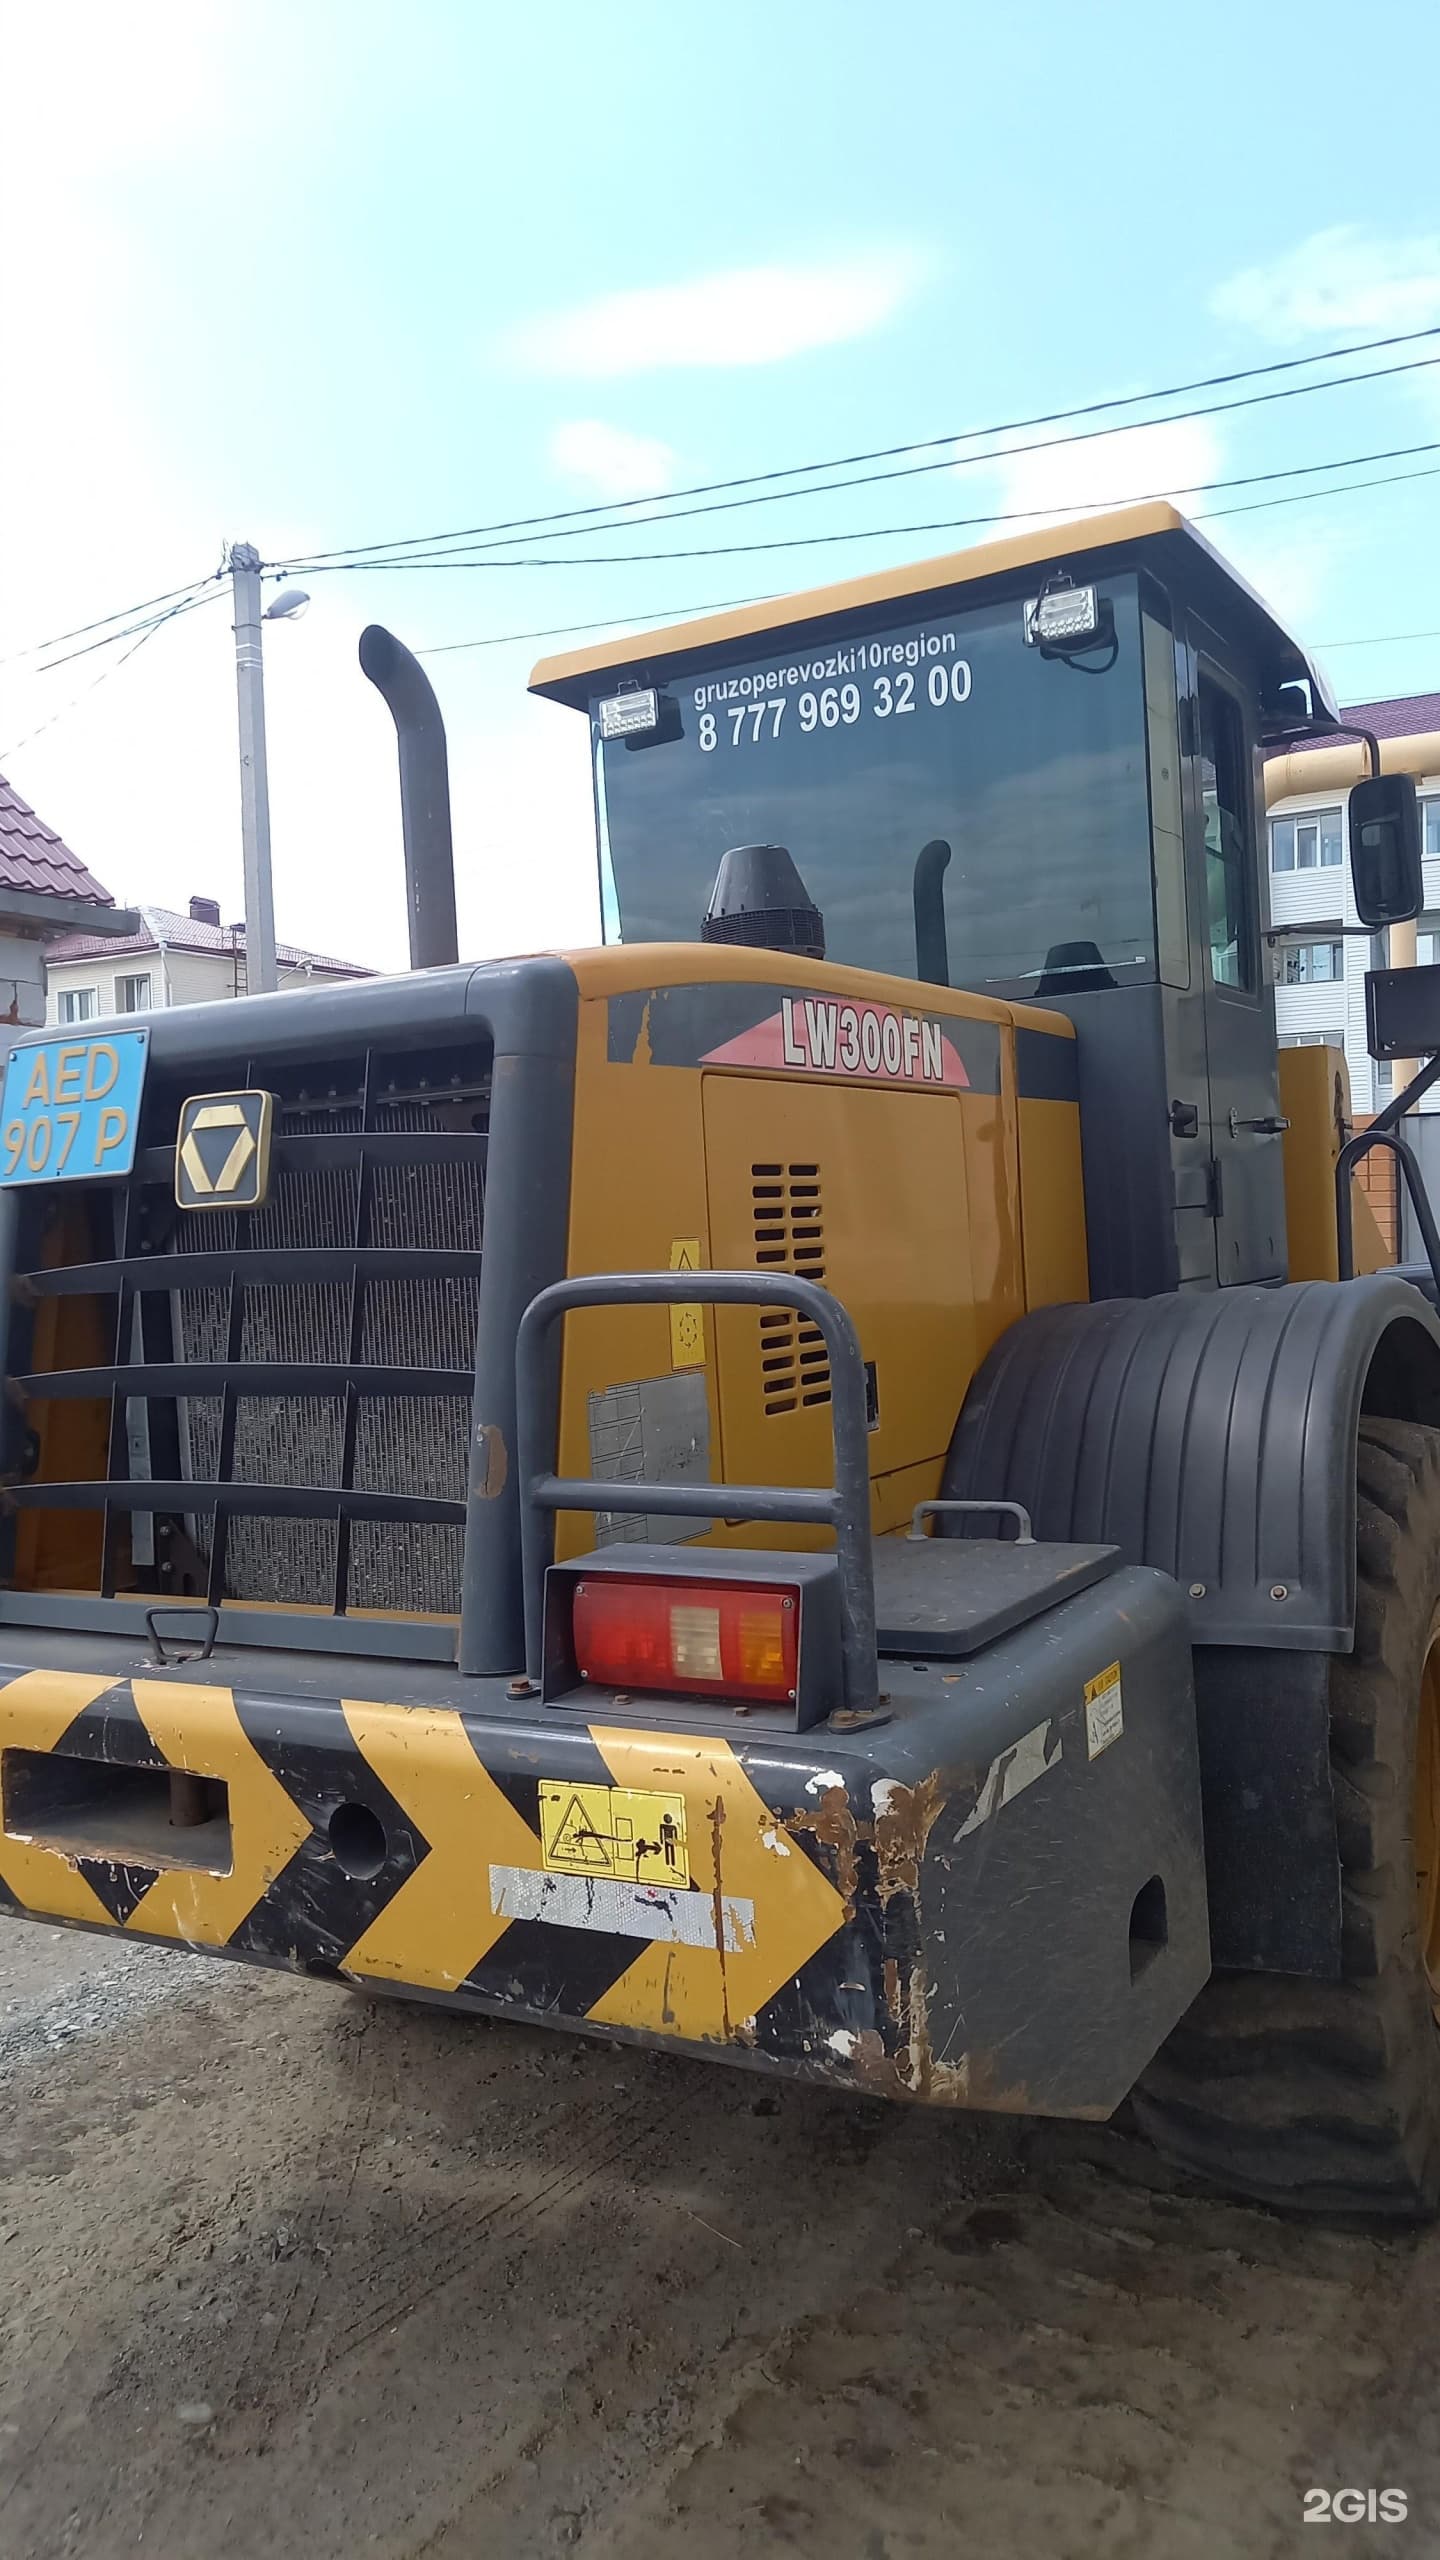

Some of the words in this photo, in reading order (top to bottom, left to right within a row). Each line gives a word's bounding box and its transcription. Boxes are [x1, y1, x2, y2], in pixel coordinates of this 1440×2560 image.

[694, 632, 957, 711] gruzoperevozki10region
[699, 713, 718, 751] 8
[728, 697, 787, 746] 777
[799, 683, 861, 732] 969
[873, 672, 916, 718] 32
[927, 661, 972, 707] 00
[22, 1043, 120, 1109] AED
[781, 997, 944, 1080] LW300FN
[4, 1112, 80, 1175] 907
[95, 1107, 128, 1166] P
